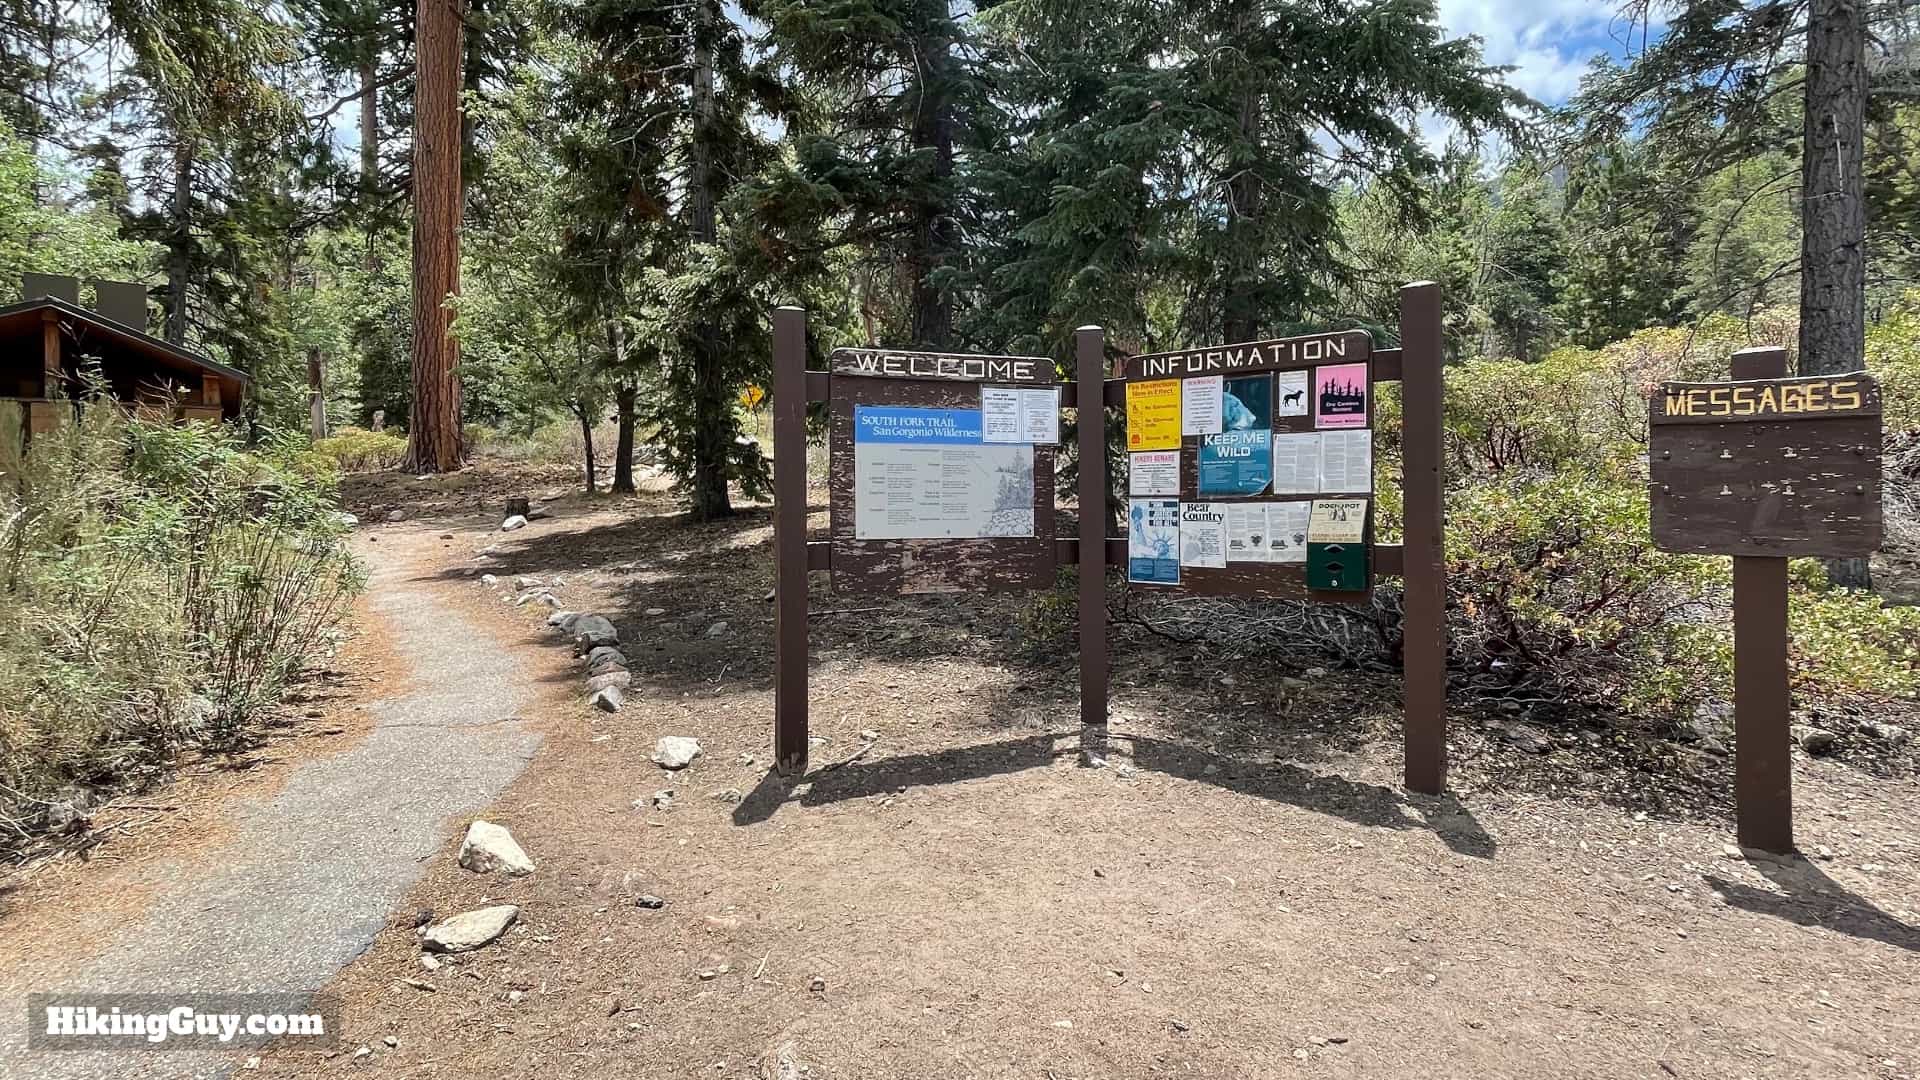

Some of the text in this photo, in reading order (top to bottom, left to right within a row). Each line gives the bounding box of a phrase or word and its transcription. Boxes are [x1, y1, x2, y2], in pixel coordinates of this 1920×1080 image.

[1143, 338, 1346, 377] INFORMATION
[855, 354, 1035, 380] WELCOME
[1665, 381, 1862, 417] MESSAGES
[861, 416, 957, 428] SOUTH FORK TRAIL
[873, 427, 893, 437] San
[892, 428, 934, 439] Gorgonio
[1204, 431, 1265, 446] KEEP ME
[1217, 446, 1251, 458] WILD
[1187, 503, 1210, 513] Bear
[1182, 511, 1224, 524] Country
